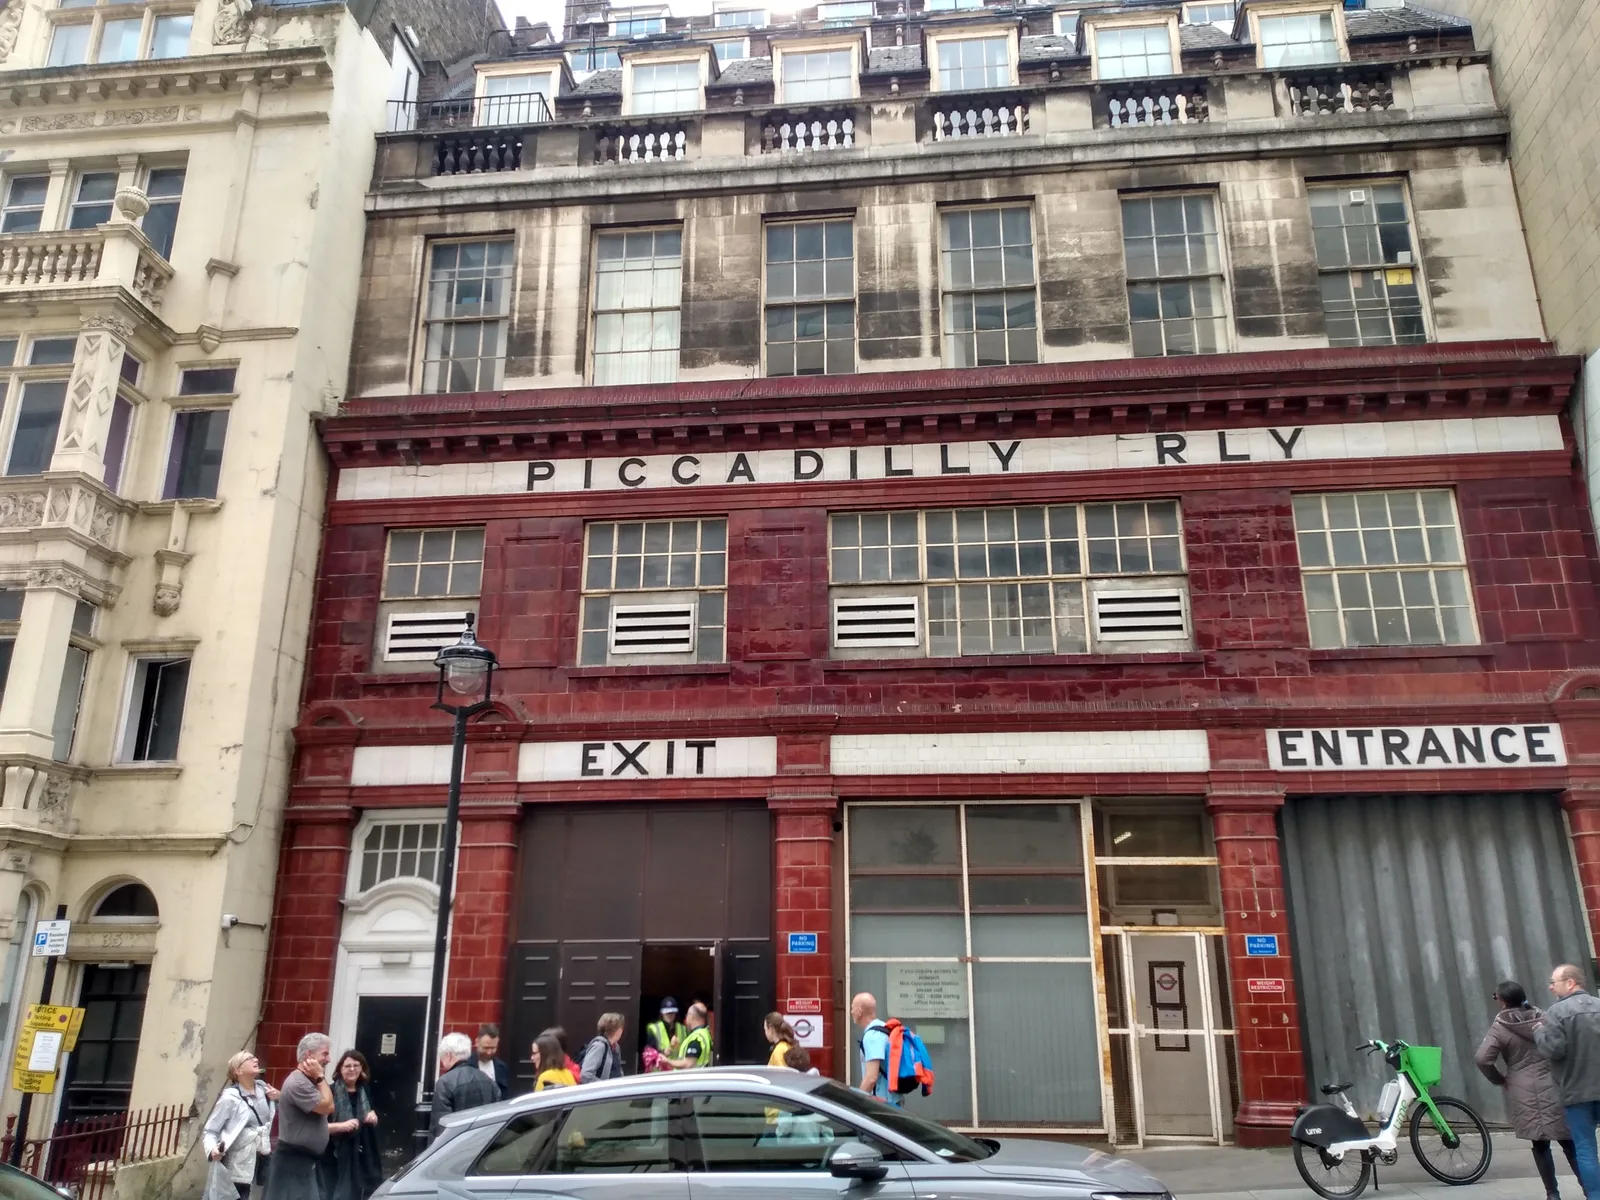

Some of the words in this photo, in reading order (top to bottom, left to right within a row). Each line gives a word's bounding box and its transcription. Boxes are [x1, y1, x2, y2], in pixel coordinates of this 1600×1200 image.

[526, 440, 1022, 492] PICCADILLY
[1155, 426, 1304, 466] RLY
[580, 740, 716, 777] EXIT
[1277, 725, 1557, 767] ENTRANCE
[38, 933, 46, 945] P
[102, 932, 122, 948] 35
